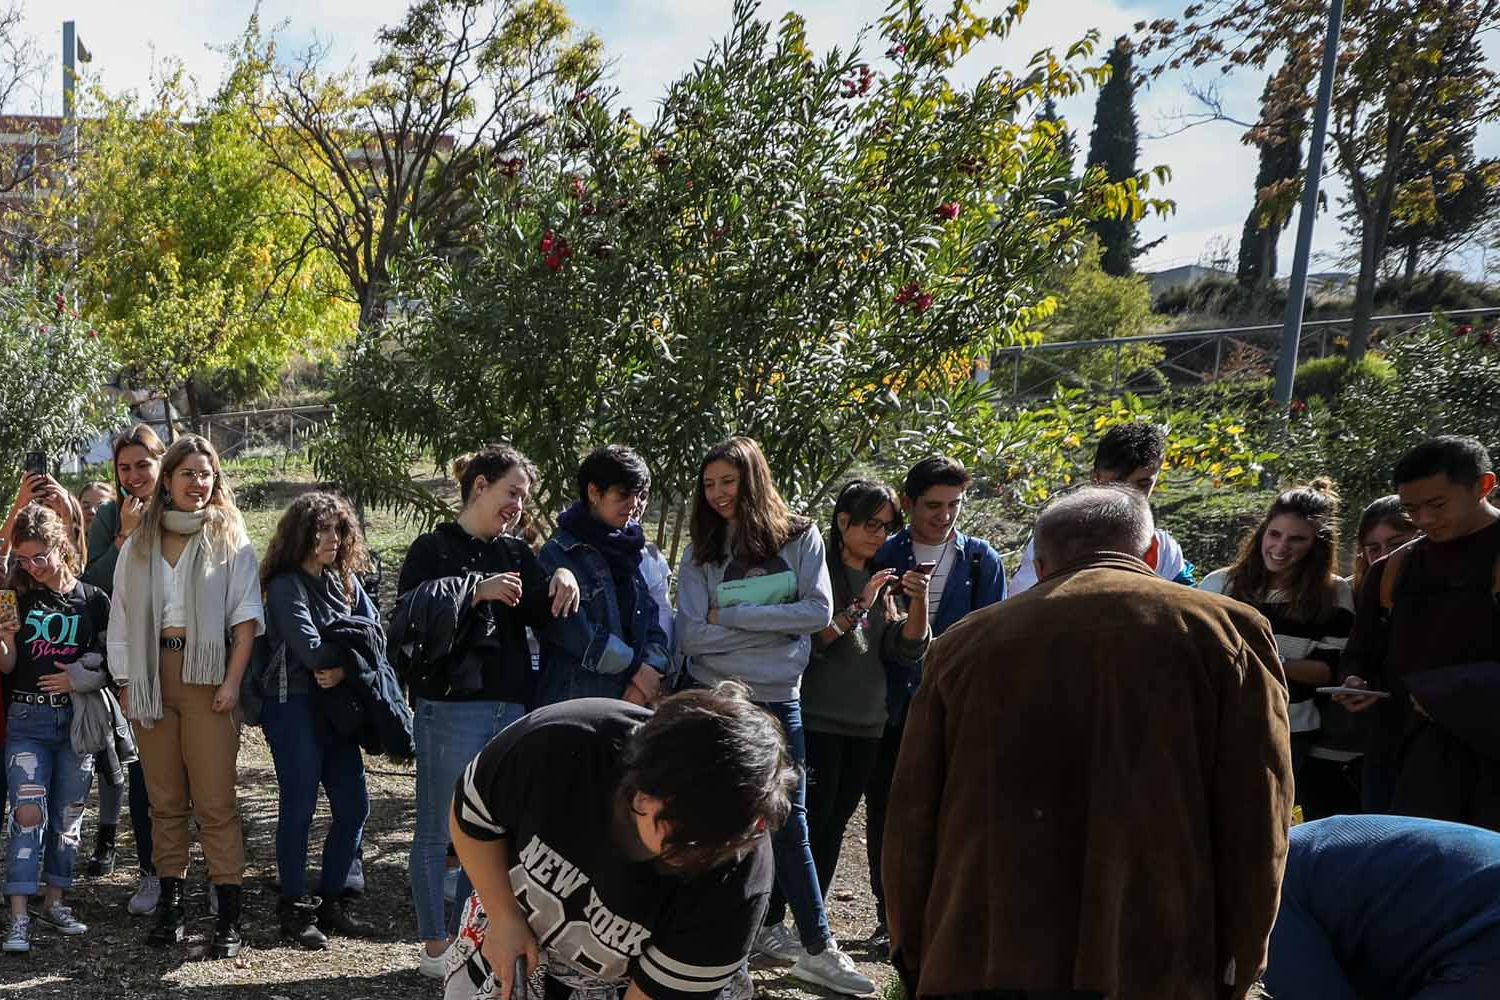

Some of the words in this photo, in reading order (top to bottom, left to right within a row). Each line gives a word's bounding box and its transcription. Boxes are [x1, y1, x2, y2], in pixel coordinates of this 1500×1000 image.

[25, 610, 81, 645] 501
[519, 835, 590, 898] NEW
[583, 886, 651, 956] YORK
